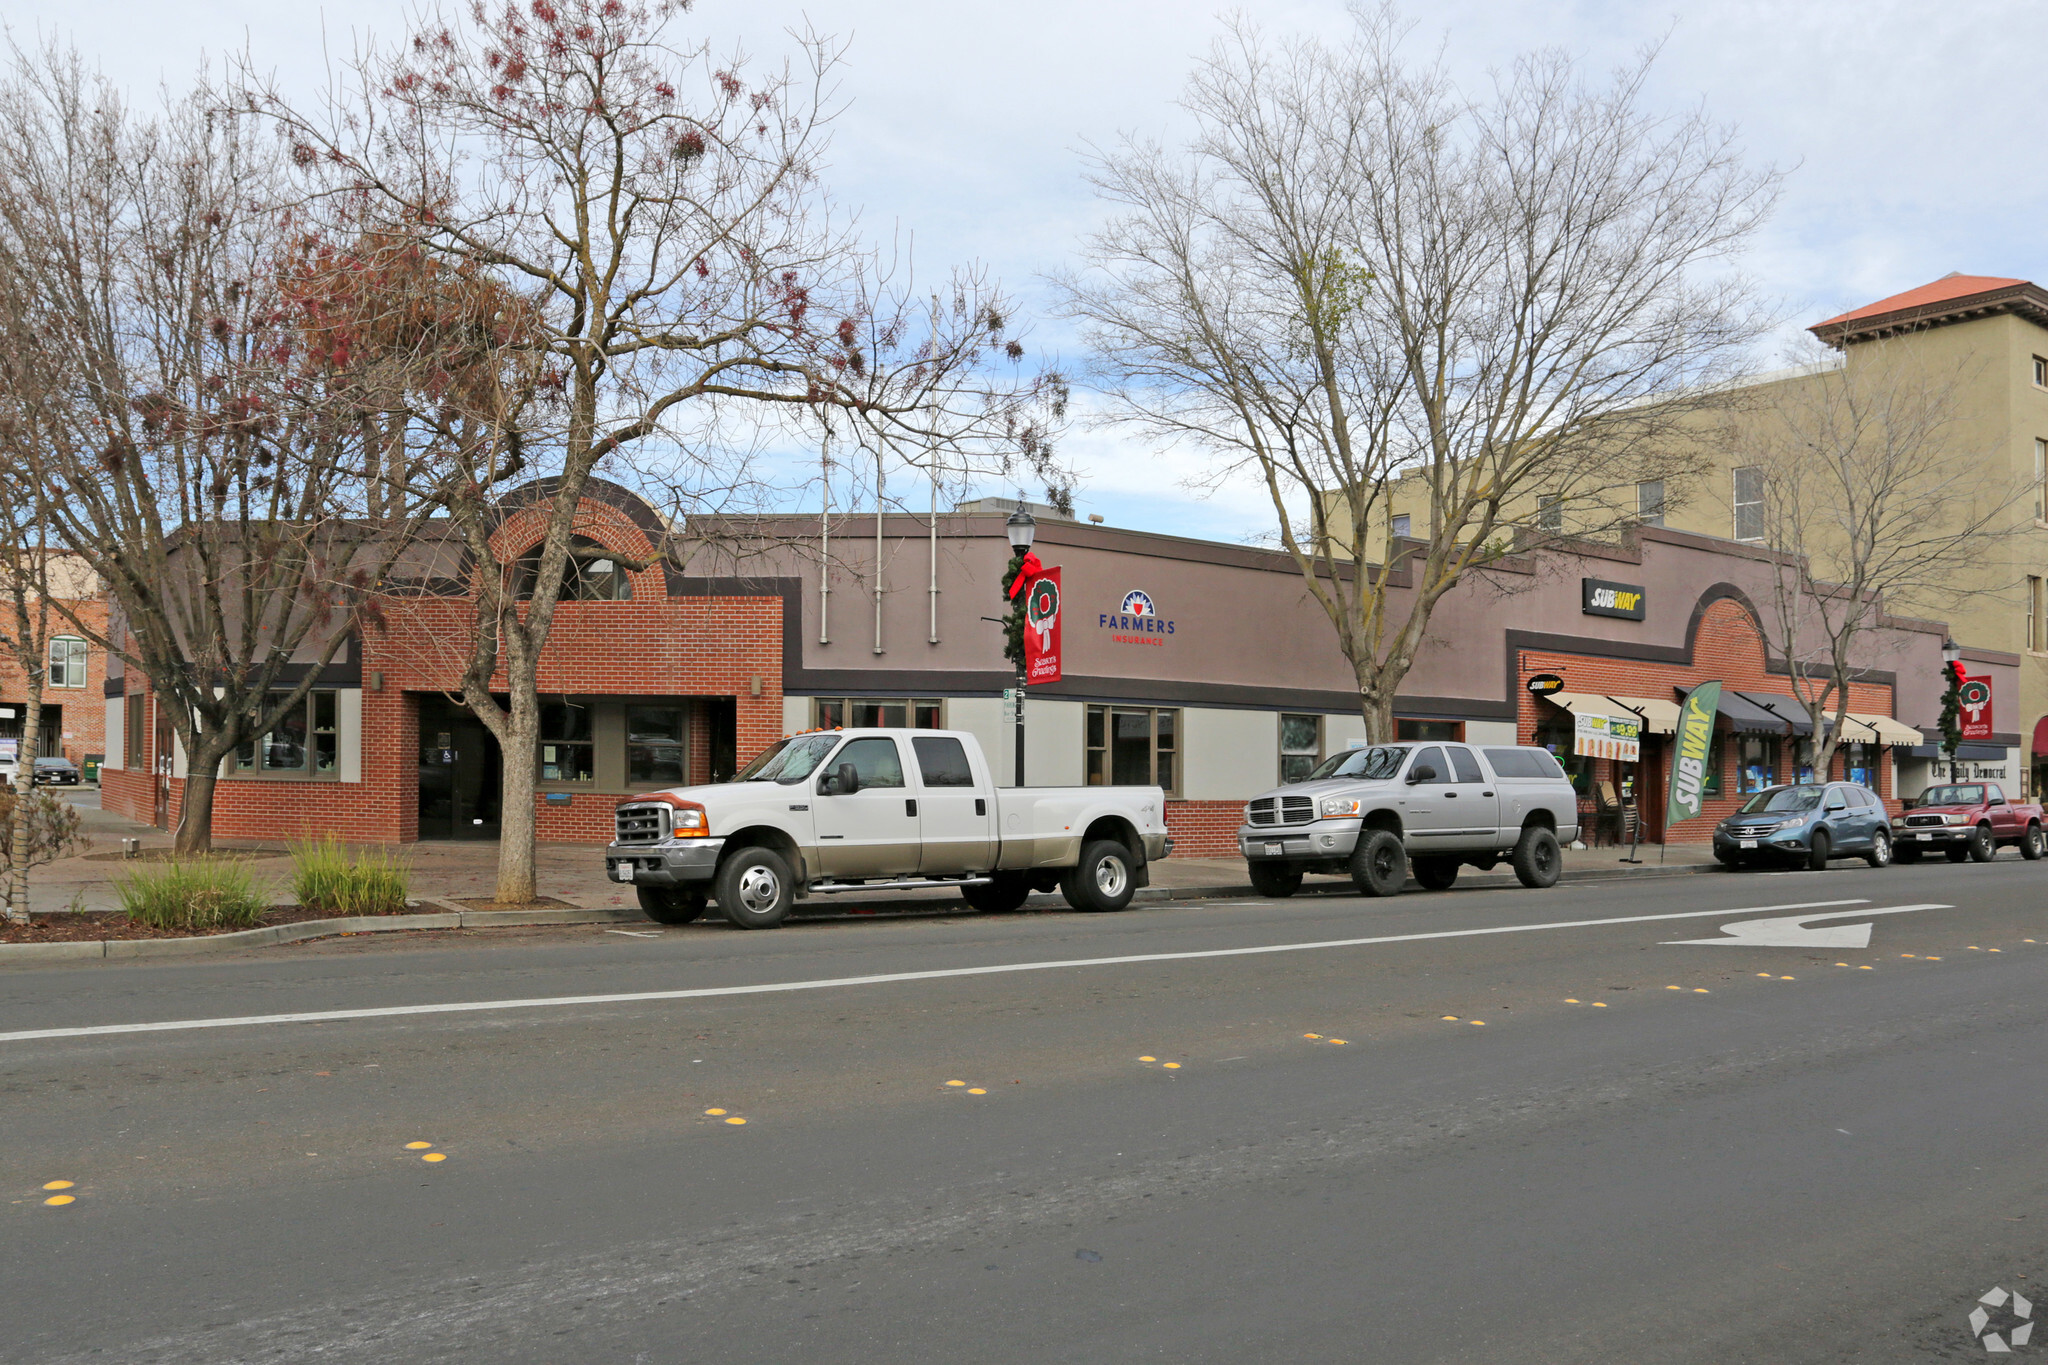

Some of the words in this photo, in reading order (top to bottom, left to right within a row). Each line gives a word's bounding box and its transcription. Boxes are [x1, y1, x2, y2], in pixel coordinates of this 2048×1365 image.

[1591, 587, 1641, 611] SUBWAY
[1099, 614, 1176, 634] FARMERS
[1112, 634, 1163, 646] INSURANCE
[1529, 679, 1561, 691] SUBWAY
[1577, 714, 1608, 729] SUBWAY
[1616, 723, 1637, 738] $9.99
[1675, 696, 1711, 816] SUBWAY
[1932, 761, 1946, 781] The
[1951, 761, 1969, 782] aily
[1973, 762, 2006, 779] Democrat
